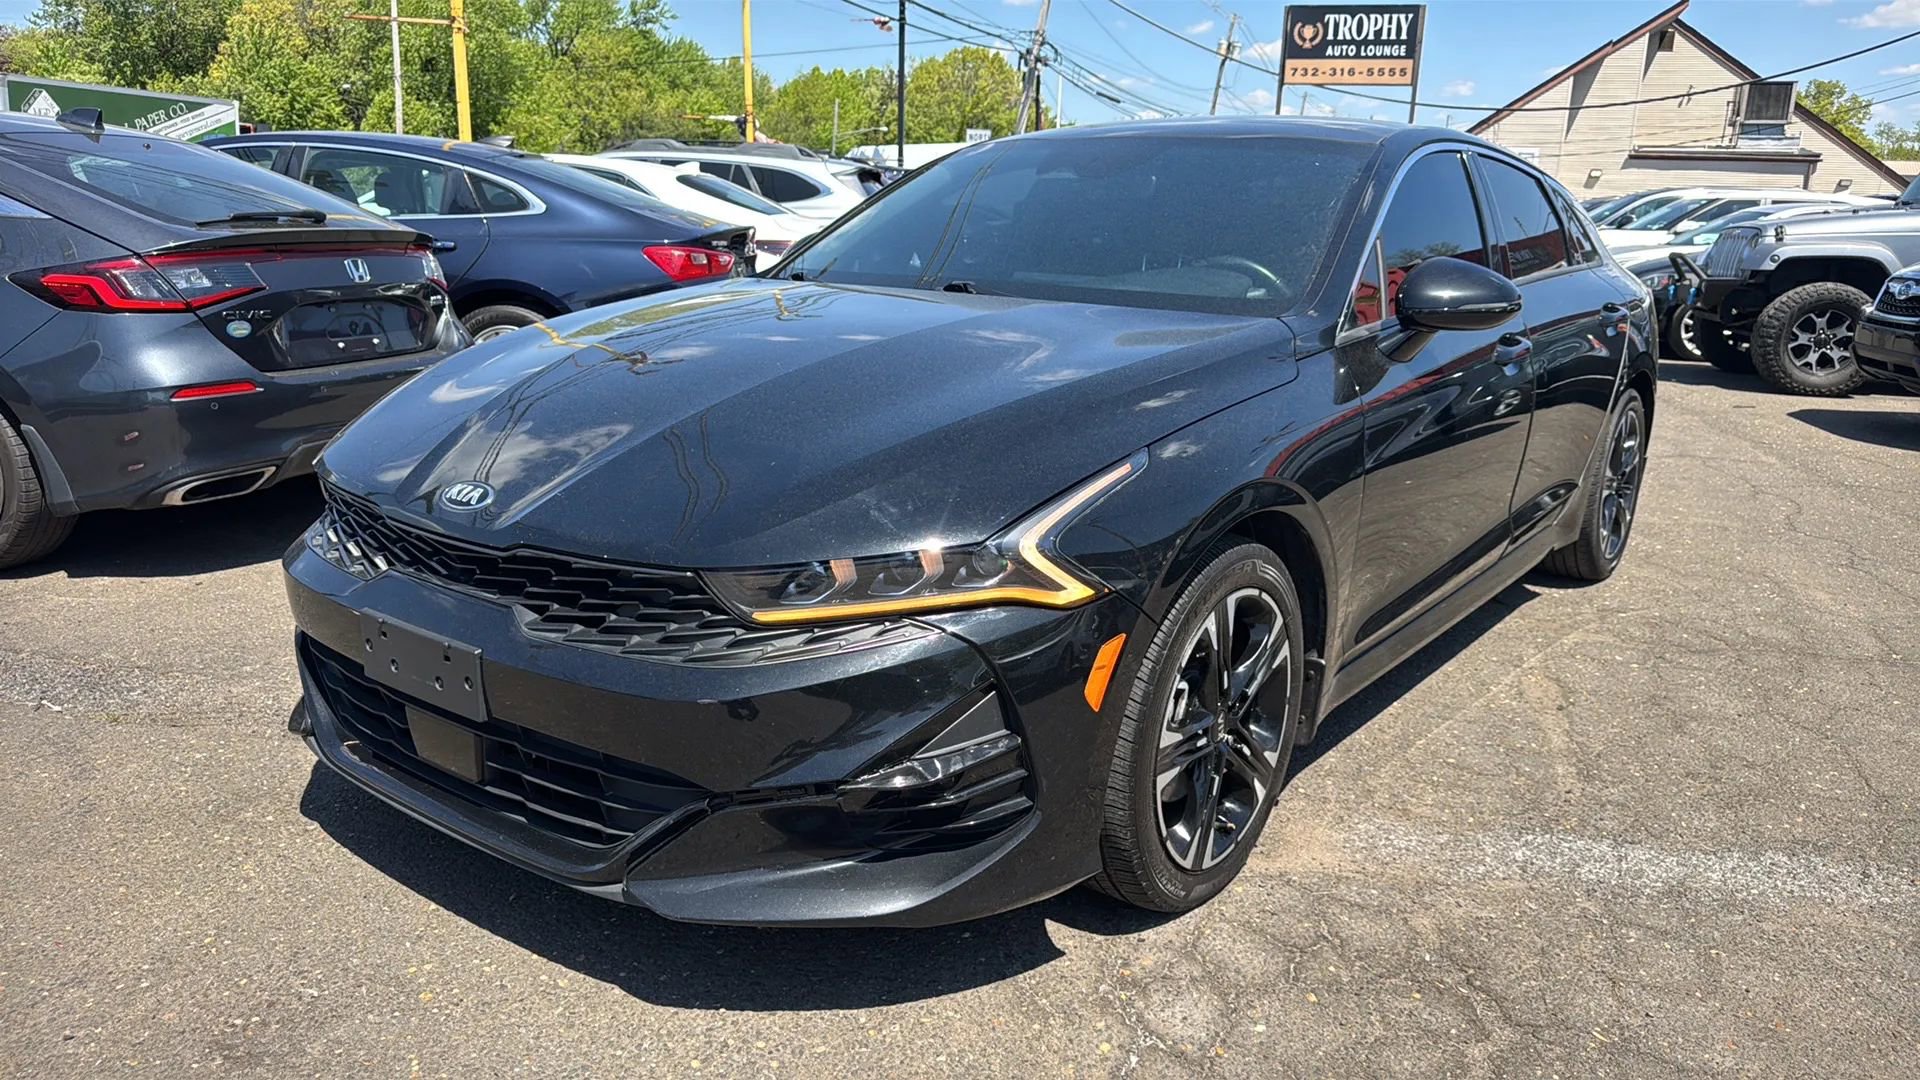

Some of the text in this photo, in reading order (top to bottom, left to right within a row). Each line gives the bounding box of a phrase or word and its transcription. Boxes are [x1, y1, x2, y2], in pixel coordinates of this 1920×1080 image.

[1325, 13, 1414, 41] TROPHY
[1325, 44, 1407, 57] AUTO LOUNGE
[1290, 67, 1408, 77] 732-316-5555
[134, 109, 169, 131] PAPER
[169, 102, 189, 118] CO.
[223, 310, 272, 319] CIVIC
[445, 483, 484, 505] KIA
